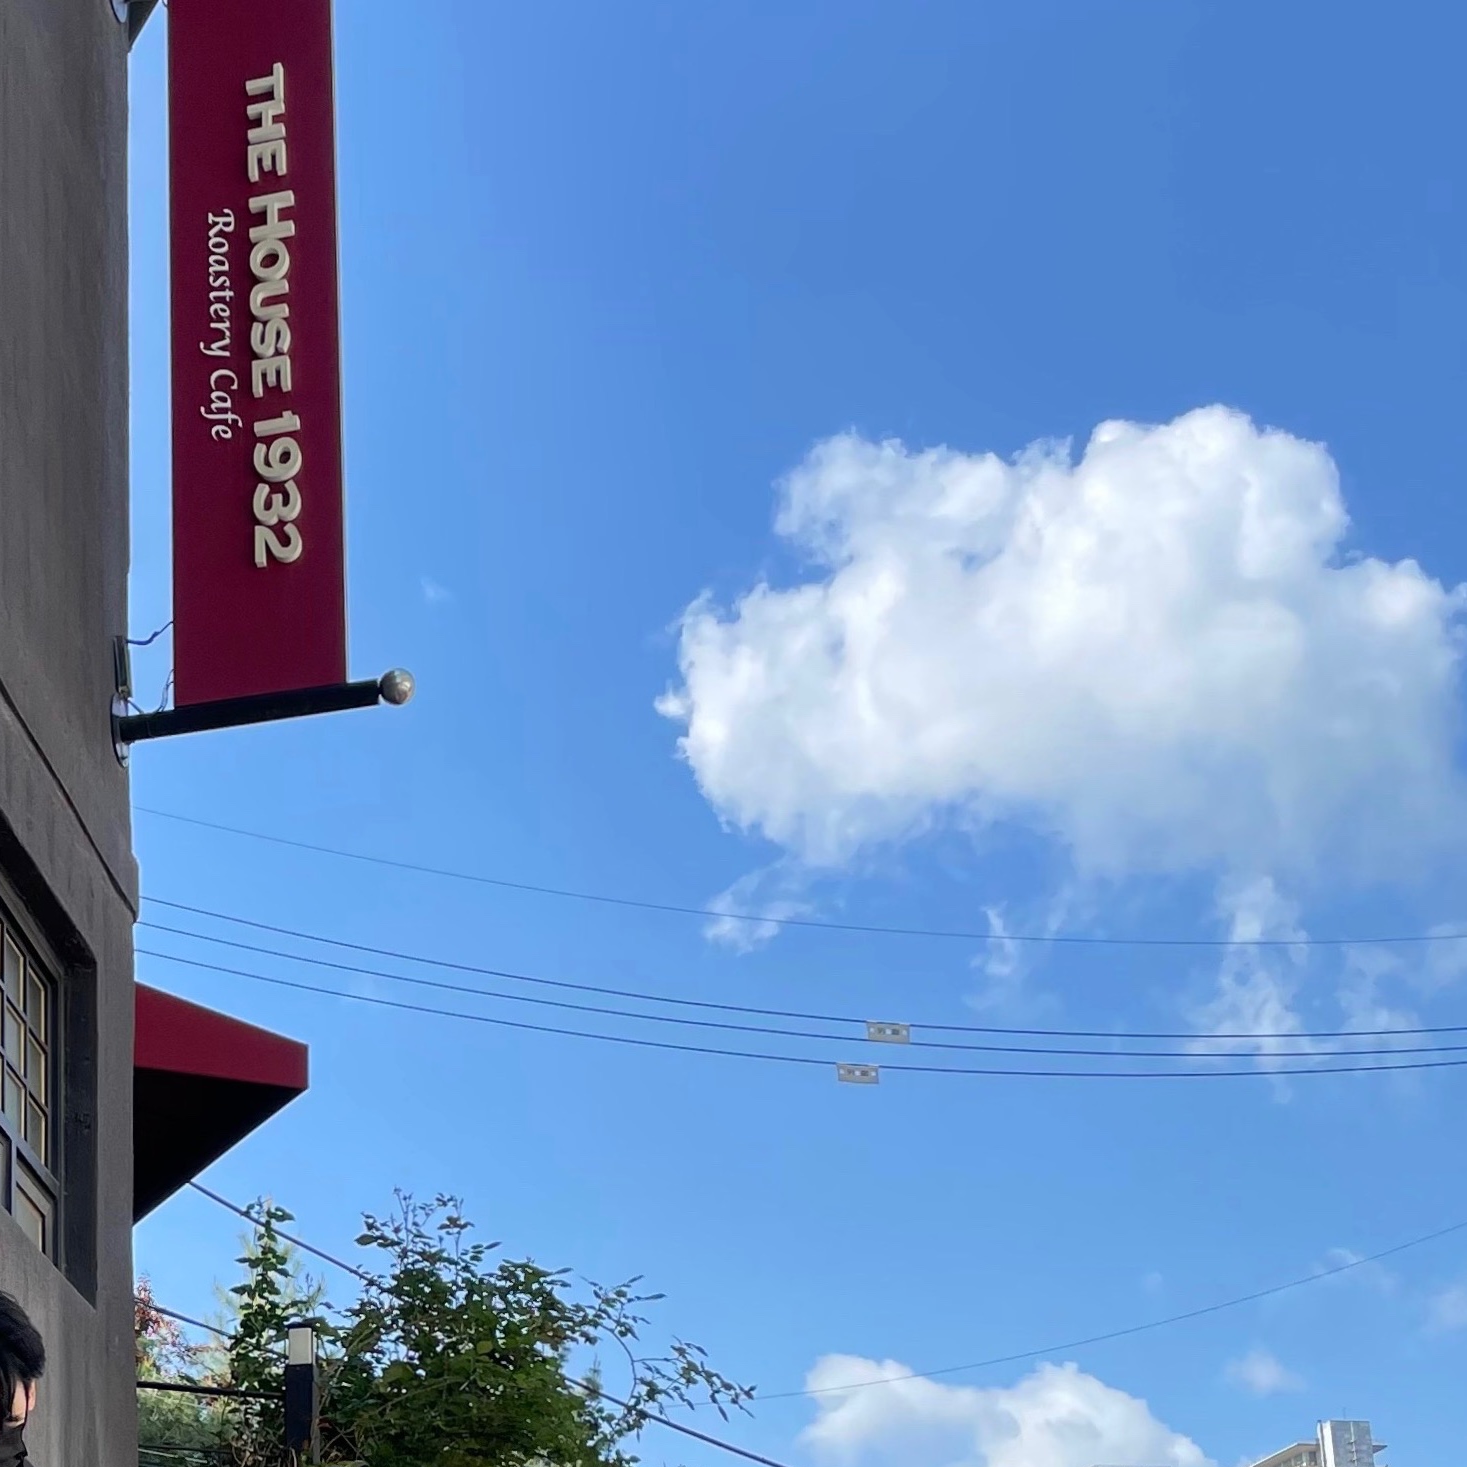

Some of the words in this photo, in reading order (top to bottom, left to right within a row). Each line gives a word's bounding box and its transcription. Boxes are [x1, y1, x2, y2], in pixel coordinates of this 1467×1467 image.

[244, 62, 287, 182] THE
[199, 208, 236, 358] Roastery
[248, 190, 296, 398] HOUSE
[199, 368, 242, 441] Cafe
[252, 409, 303, 569] 1932
